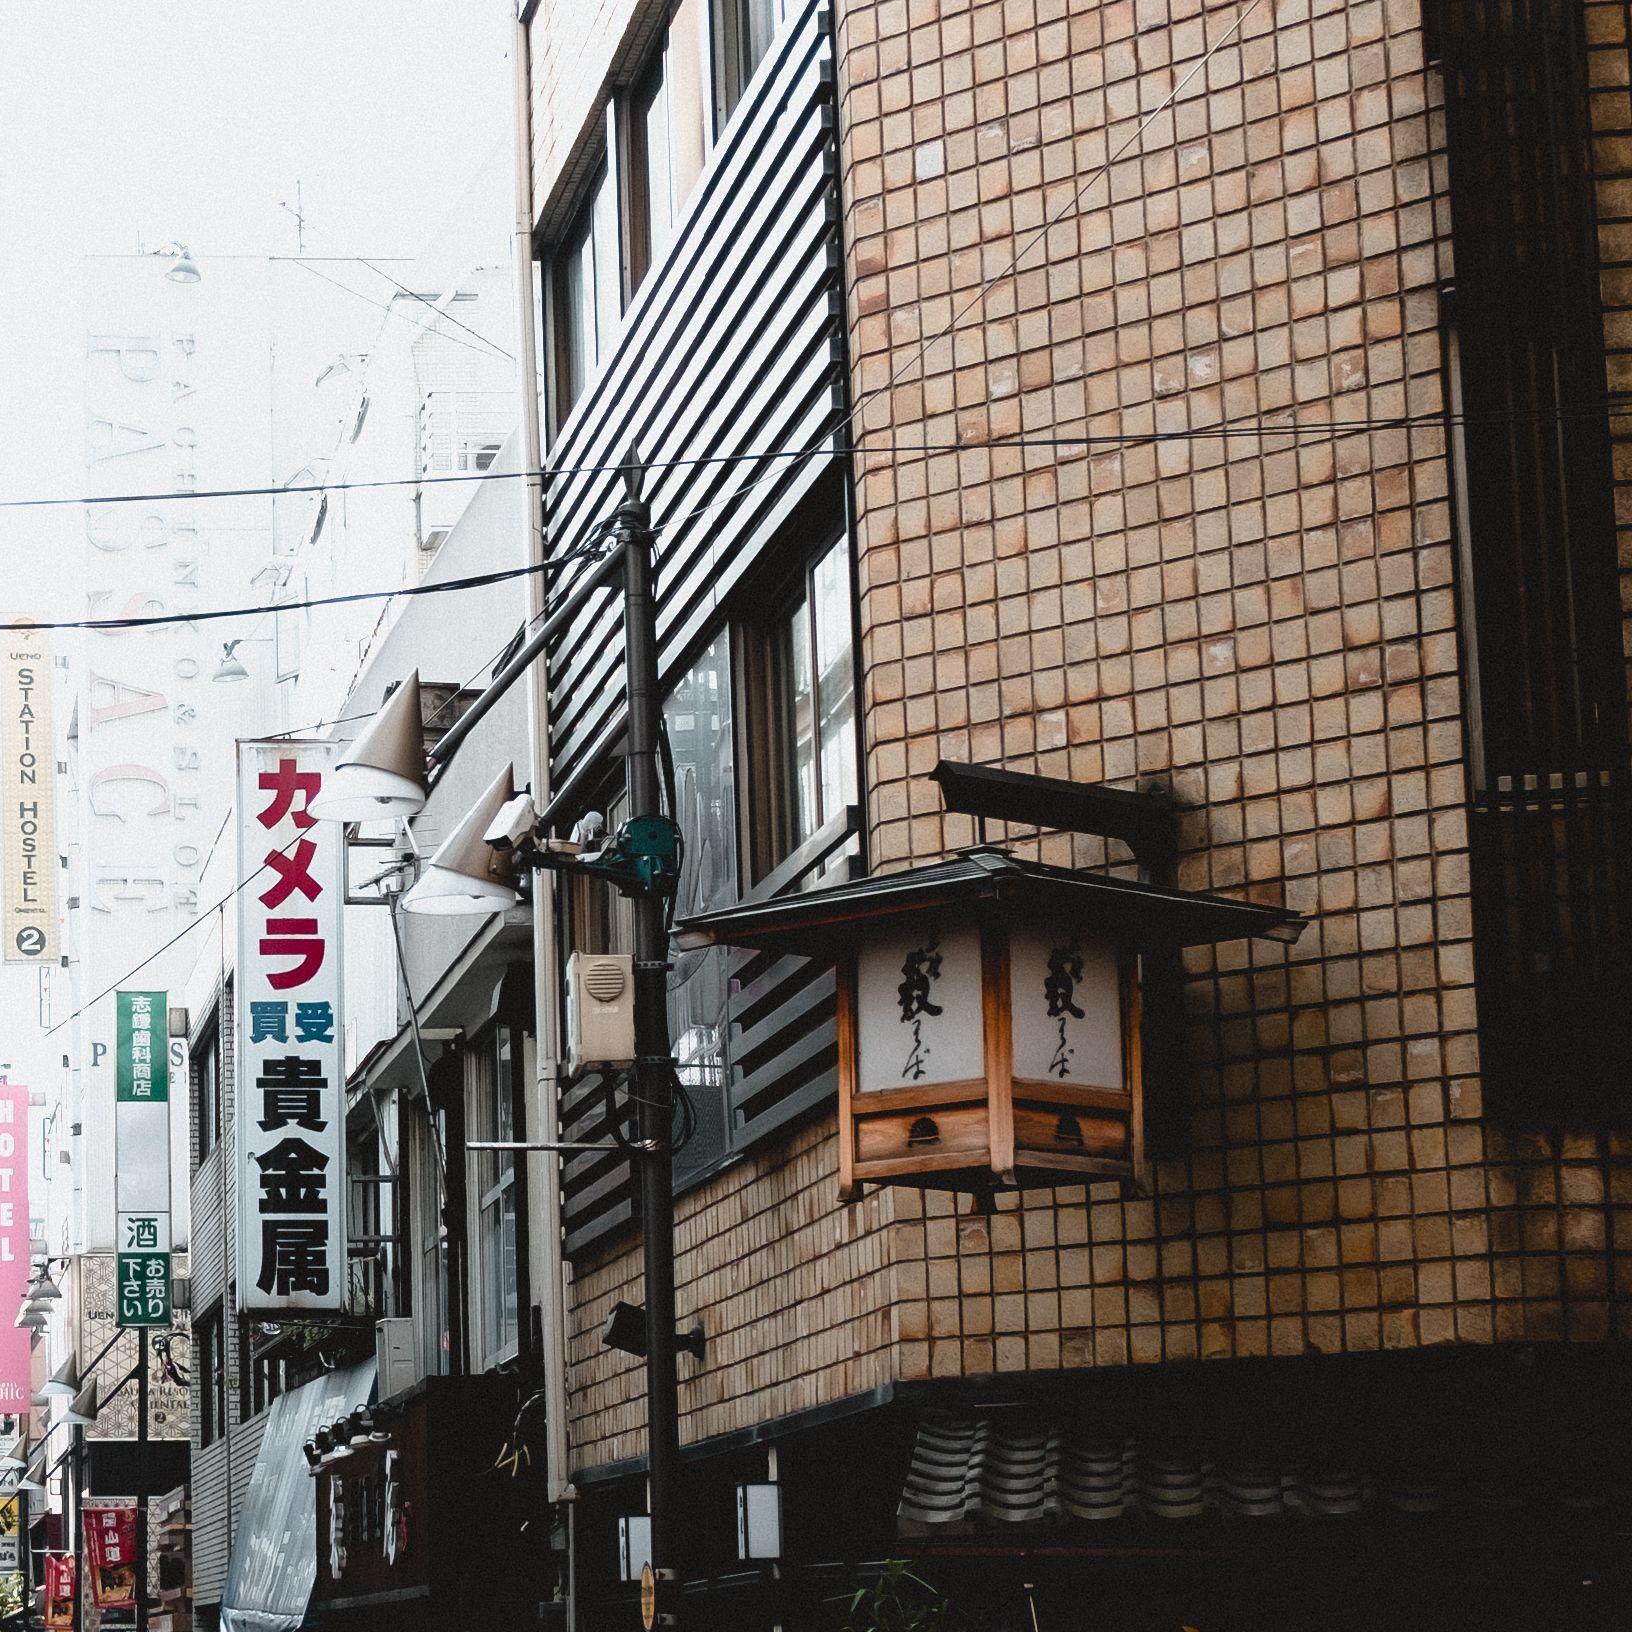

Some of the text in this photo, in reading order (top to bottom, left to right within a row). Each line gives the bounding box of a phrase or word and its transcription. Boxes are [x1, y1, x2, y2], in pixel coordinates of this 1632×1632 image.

[18, 668, 38, 902] STATION HOSTEL
[256, 759, 325, 990] カメラ
[20, 930, 41, 952] 2
[249, 1000, 336, 1045] 買受
[256, 1055, 331, 1297] 貴金属
[127, 1217, 158, 1249] 酒
[88, 1310, 114, 1319] UEN
[122, 1259, 142, 1317] 下さい
[146, 1259, 165, 1317] お売り
